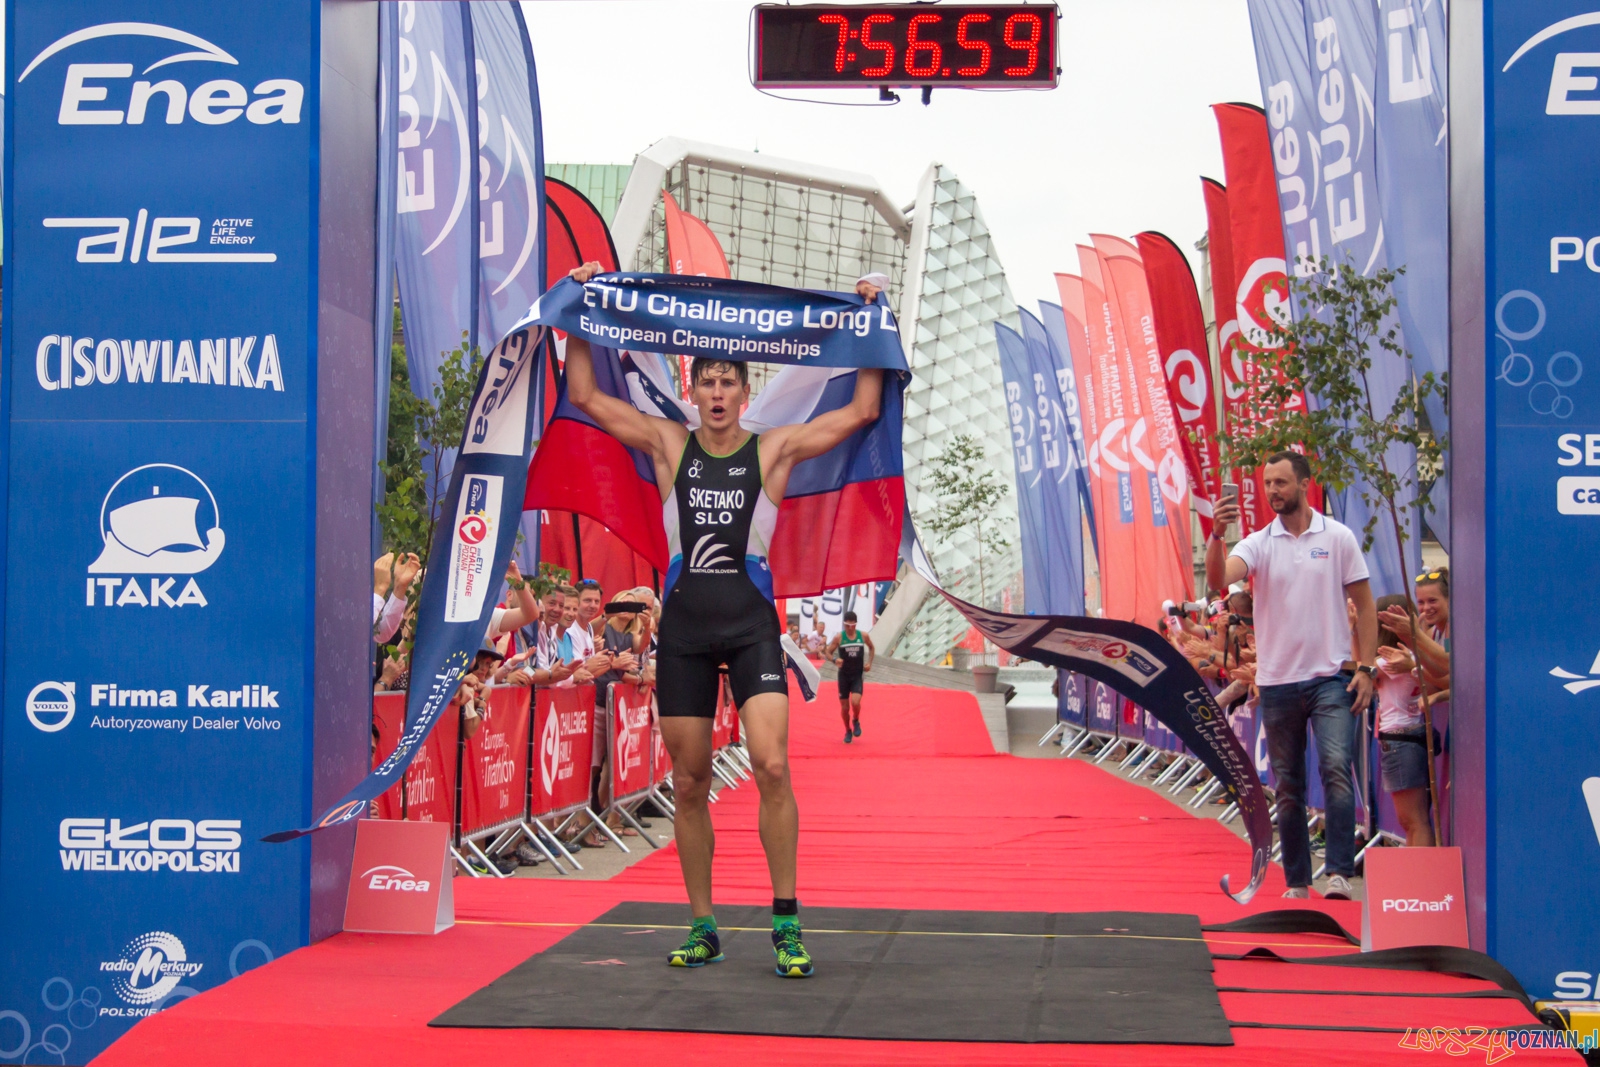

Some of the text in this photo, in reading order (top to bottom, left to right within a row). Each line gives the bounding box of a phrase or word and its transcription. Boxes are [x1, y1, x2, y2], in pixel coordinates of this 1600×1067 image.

[57, 62, 304, 125] Enea
[211, 227, 237, 236] LIFE
[212, 218, 254, 227] ACTIVE
[209, 236, 256, 245] ENERGY
[582, 282, 639, 312] ETU
[647, 293, 793, 333] Challenge
[803, 305, 871, 337] Long
[579, 315, 821, 360] European Championships
[35, 333, 285, 393] CISOWIANKA
[470, 328, 529, 444] Enea
[470, 484, 479, 507] Enea
[689, 487, 745, 509] SKETAKO
[694, 511, 733, 525] SLO
[465, 546, 477, 597] CHALLENGE
[86, 577, 208, 607] ITAKA
[90, 683, 178, 707] Firma
[187, 684, 280, 708] Karlik
[90, 715, 281, 732] Autoryzowany Dealer Volvo
[60, 818, 242, 850] GŁOS
[60, 850, 241, 873] WIELKOPOLSKI
[368, 875, 431, 892] Enea
[99, 946, 204, 988] radio Merkury
